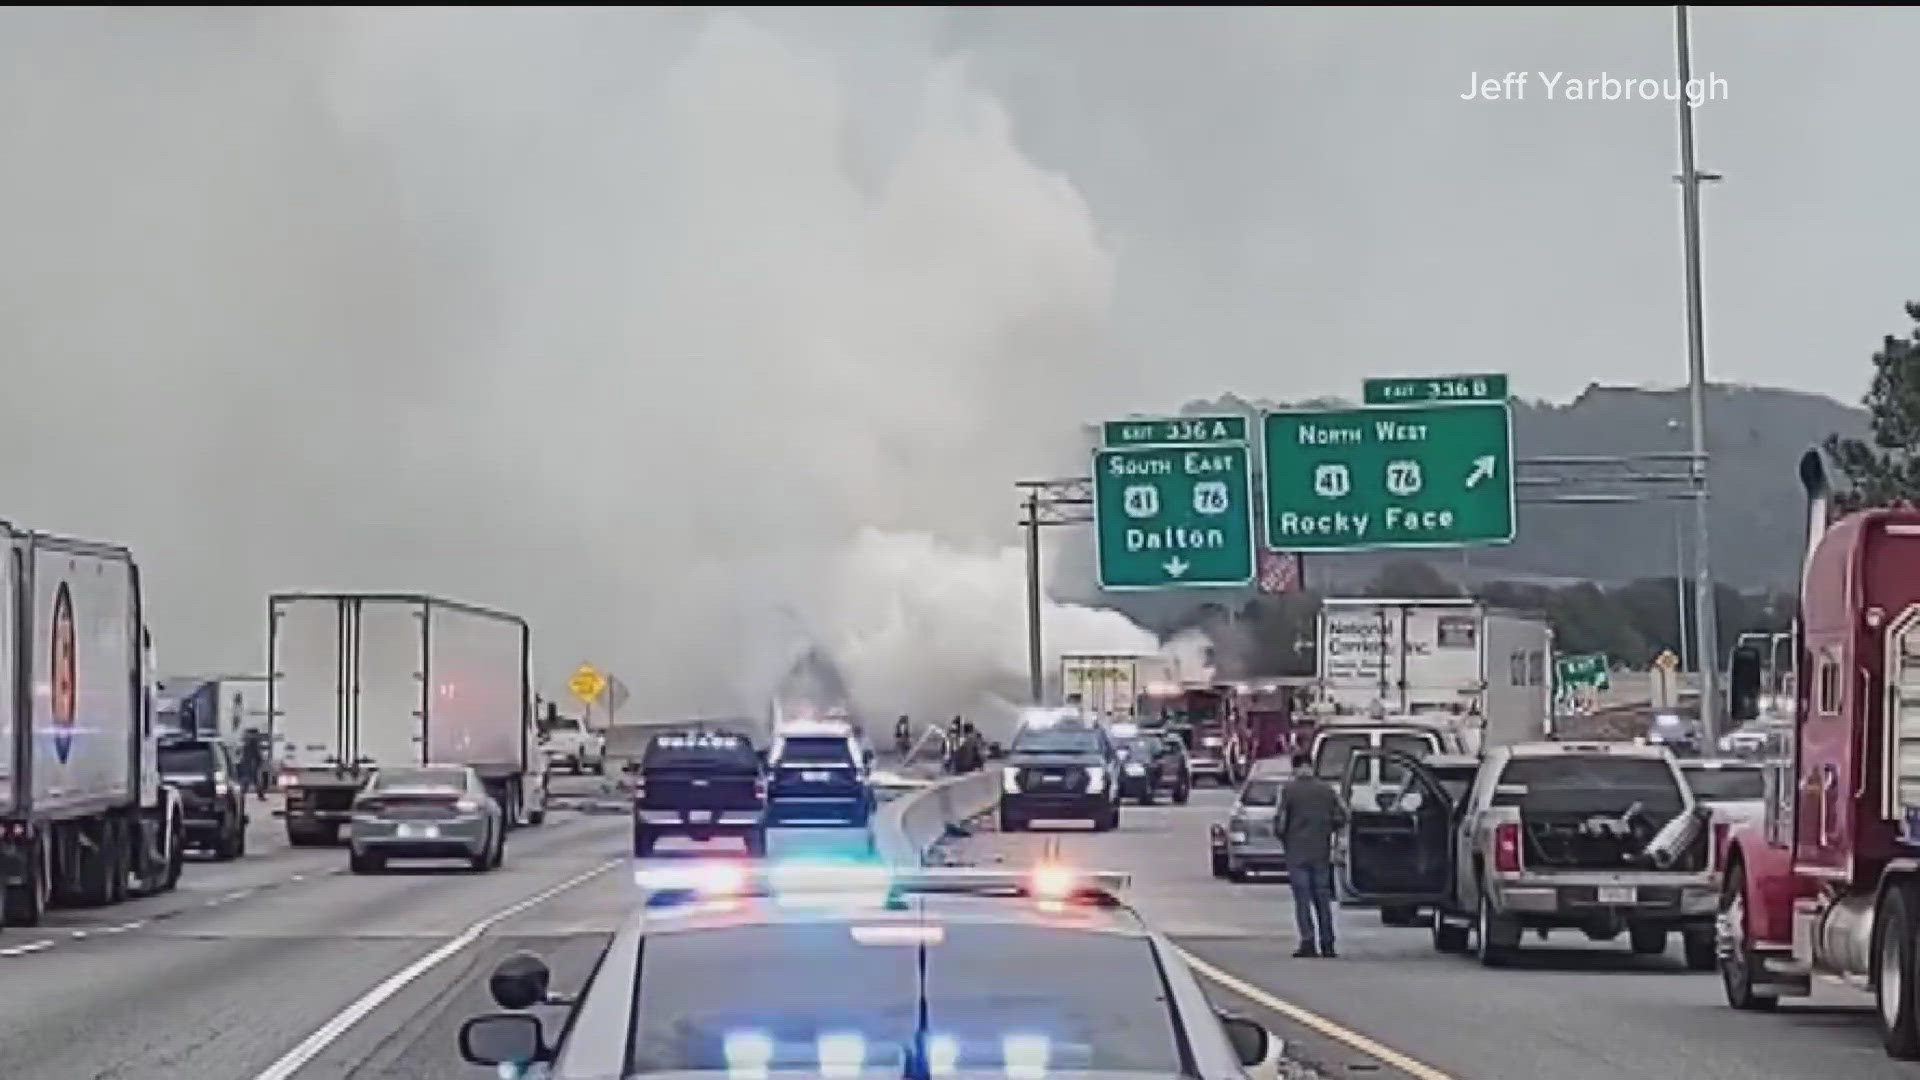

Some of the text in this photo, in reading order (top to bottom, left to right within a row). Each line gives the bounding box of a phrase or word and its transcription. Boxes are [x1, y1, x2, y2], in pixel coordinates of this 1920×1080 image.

[1320, 469, 1417, 492] 41 76
[1130, 490, 1224, 509] 41 76
[1281, 506, 1454, 538] Rocky Face
[1126, 526, 1224, 551] Dalton
